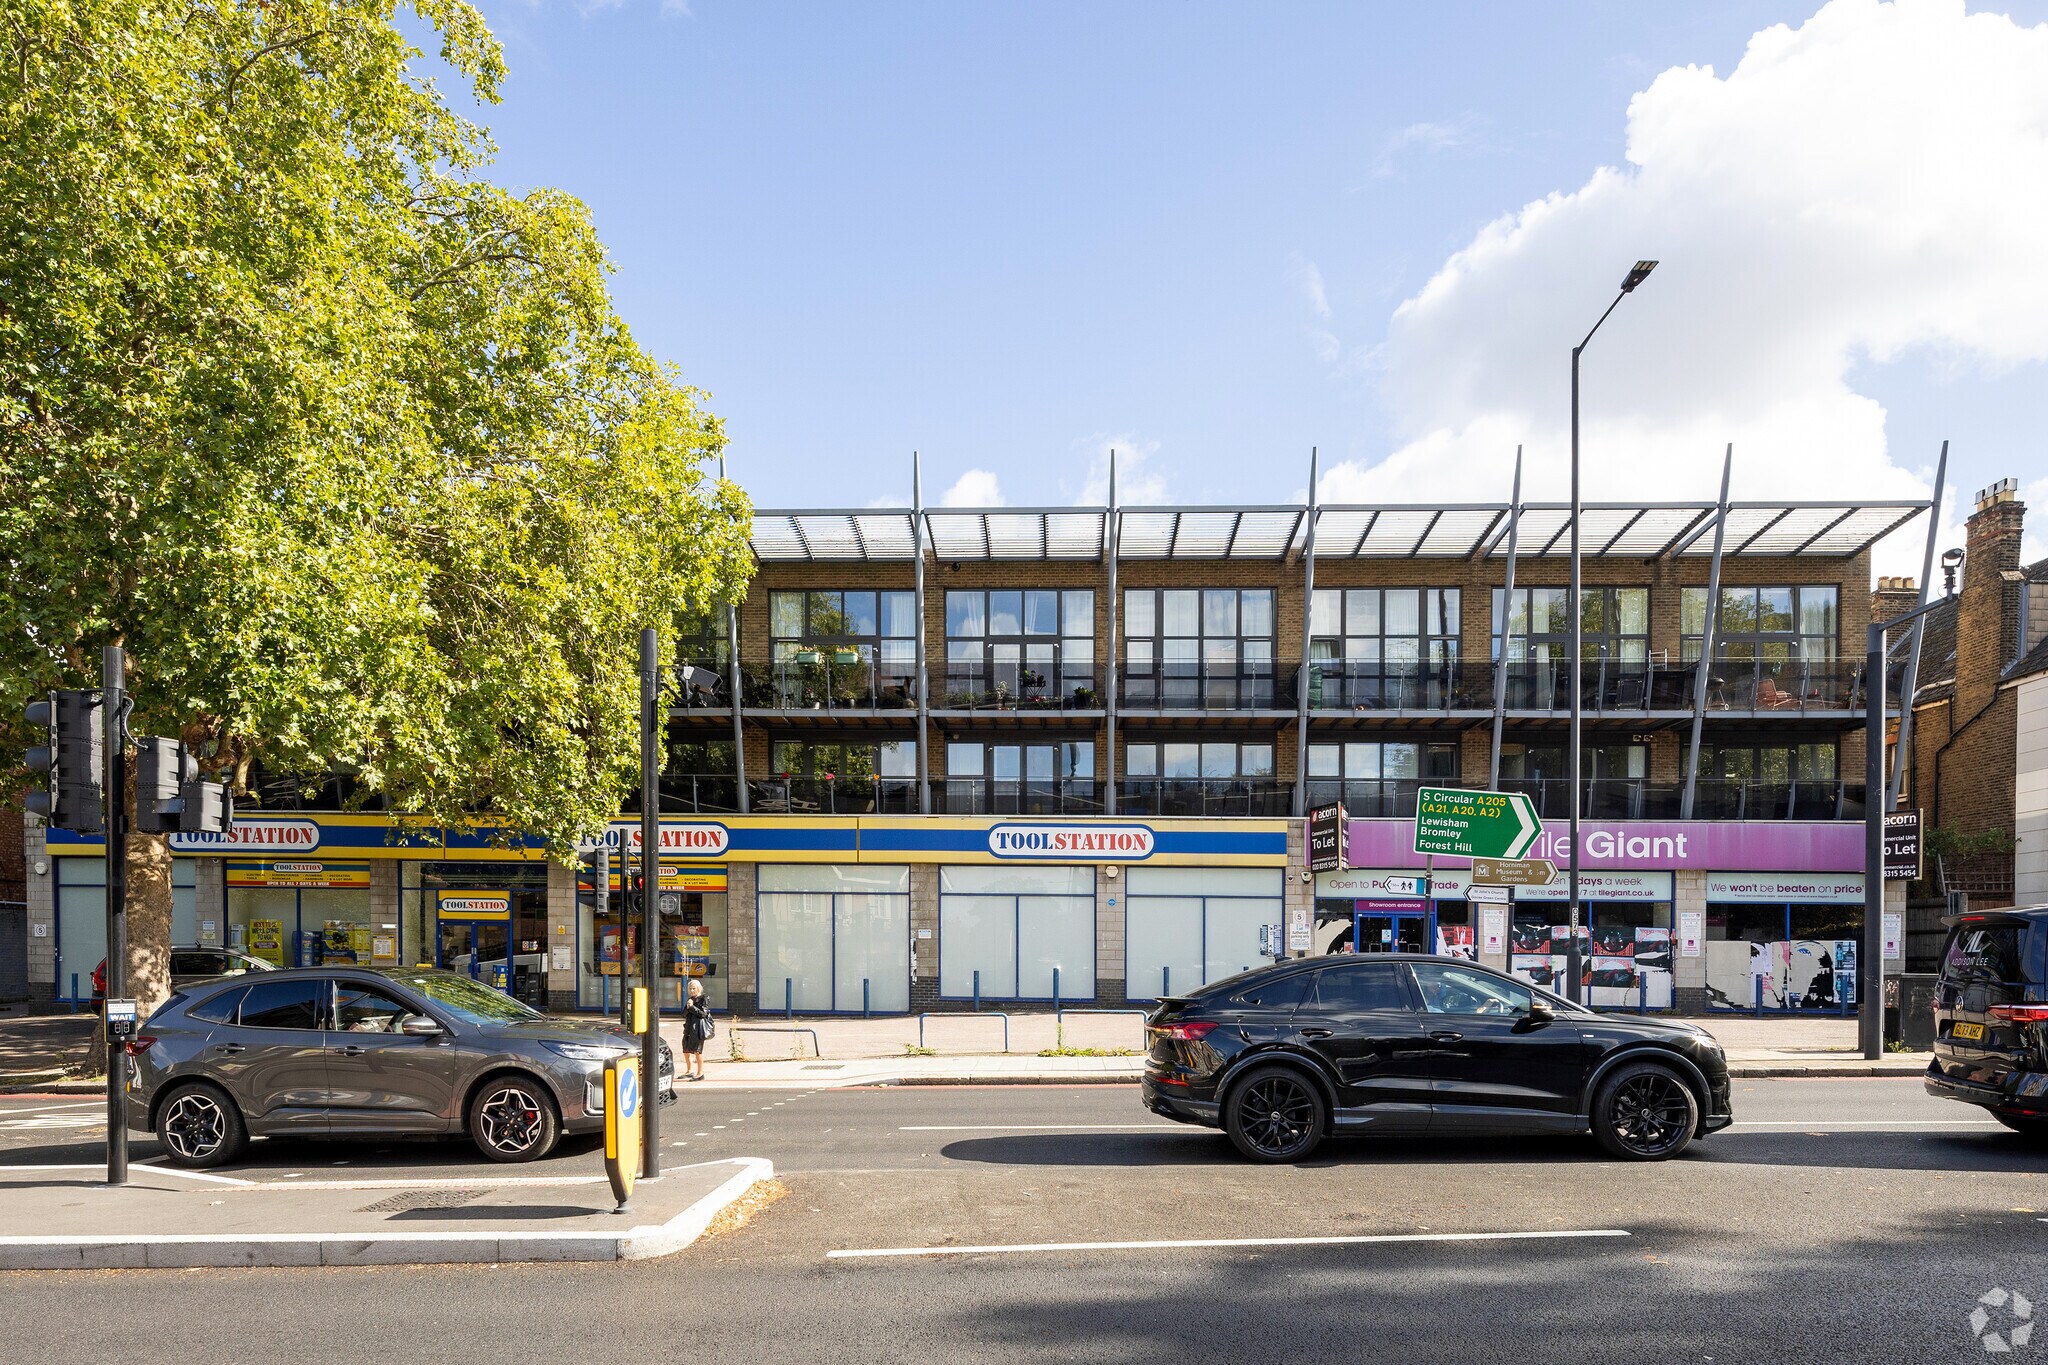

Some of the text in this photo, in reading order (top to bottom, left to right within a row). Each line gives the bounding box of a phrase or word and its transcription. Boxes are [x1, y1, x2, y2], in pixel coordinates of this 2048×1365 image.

[1423, 792, 1430, 801] S
[1433, 793, 1474, 804] Circular
[1318, 807, 1337, 819] acorn
[1421, 816, 1469, 829] Lewisham
[1884, 815, 1917, 825] acorn
[175, 827, 314, 844] TOOLSTATION
[1420, 827, 1462, 840] Bromley
[996, 832, 1147, 851] TOOLSTATION
[1311, 838, 1322, 850] To
[1322, 836, 1335, 848] Let
[1419, 840, 1473, 853] Forest Hill
[1585, 830, 1688, 859] Giant
[1884, 843, 1916, 856] o Let
[1330, 880, 1357, 888] Open
[1431, 880, 1459, 889] Trade
[1615, 878, 1642, 886] week
[1598, 890, 1654, 898] tilegiant.co.uk
[1711, 884, 1726, 892] We
[1760, 884, 1774, 892] be
[1777, 884, 1815, 893] beaten
[445, 901, 506, 909] TOOLSTATION
[1976, 958, 1988, 966] LEE
